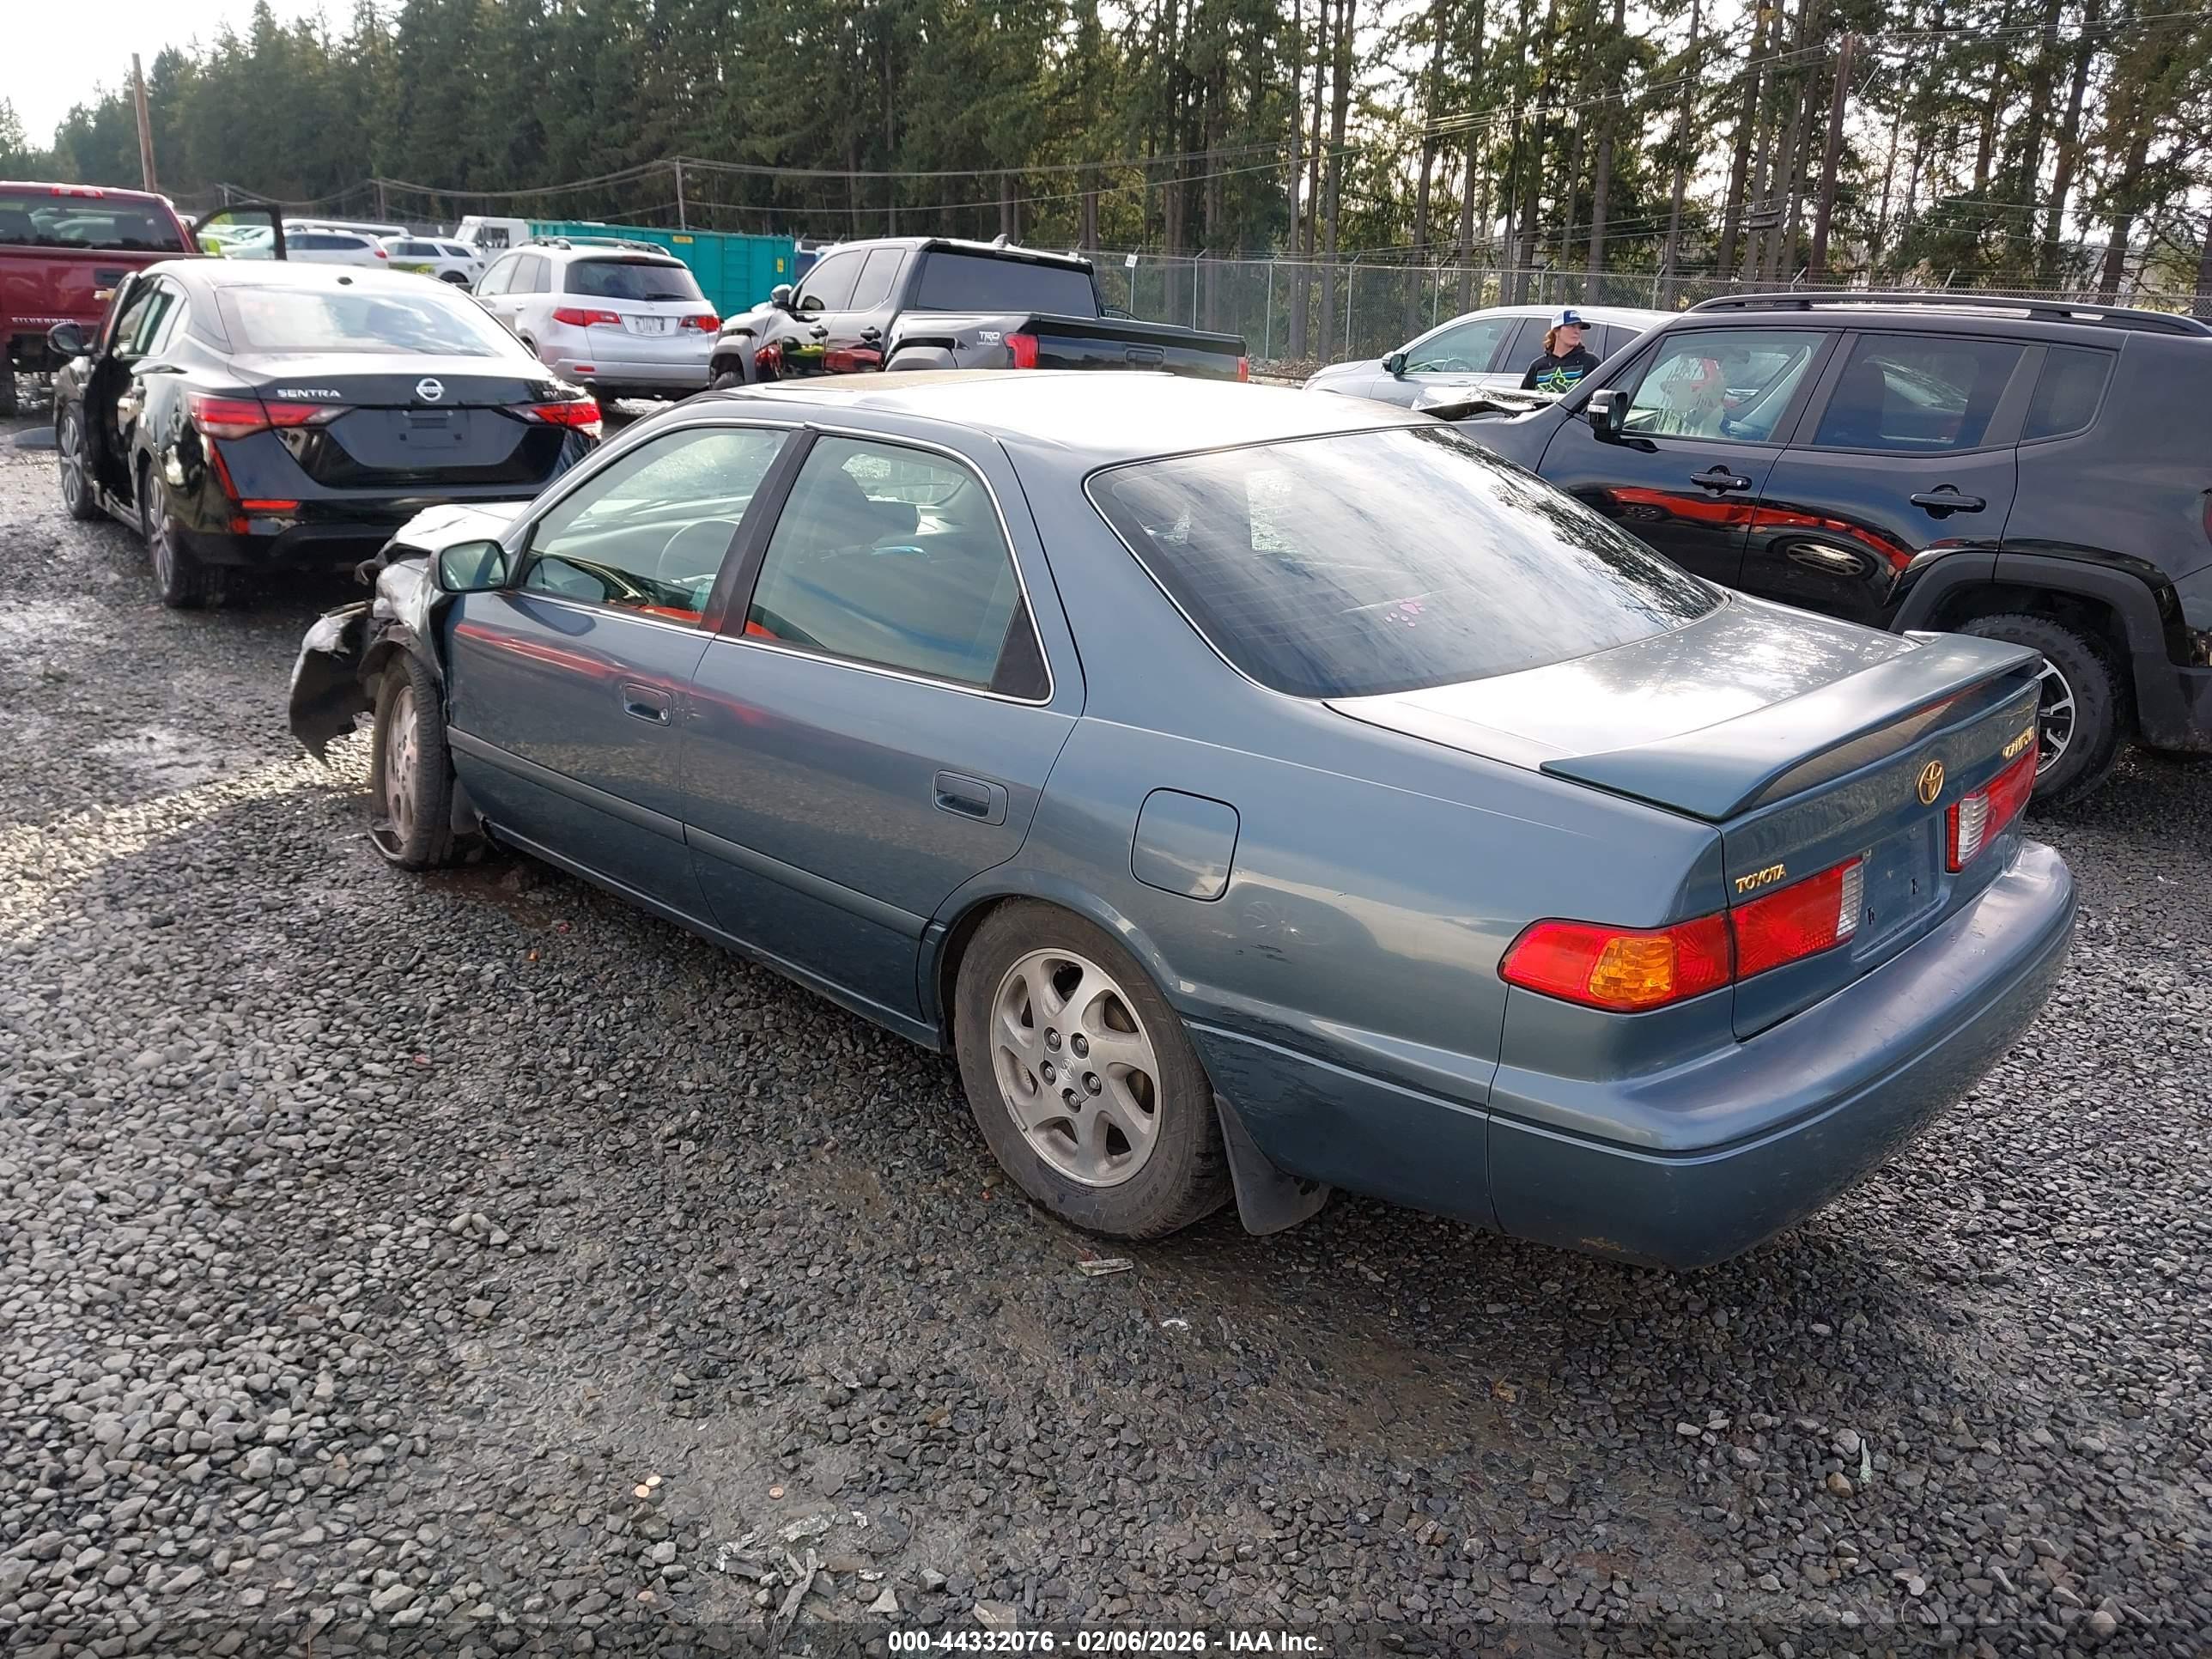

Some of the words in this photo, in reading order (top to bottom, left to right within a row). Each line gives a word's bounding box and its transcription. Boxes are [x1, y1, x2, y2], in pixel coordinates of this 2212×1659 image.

[979, 331, 1000, 343] TRD
[276, 388, 342, 398] SENTRA
[1735, 864, 1786, 894] TOYOTA
